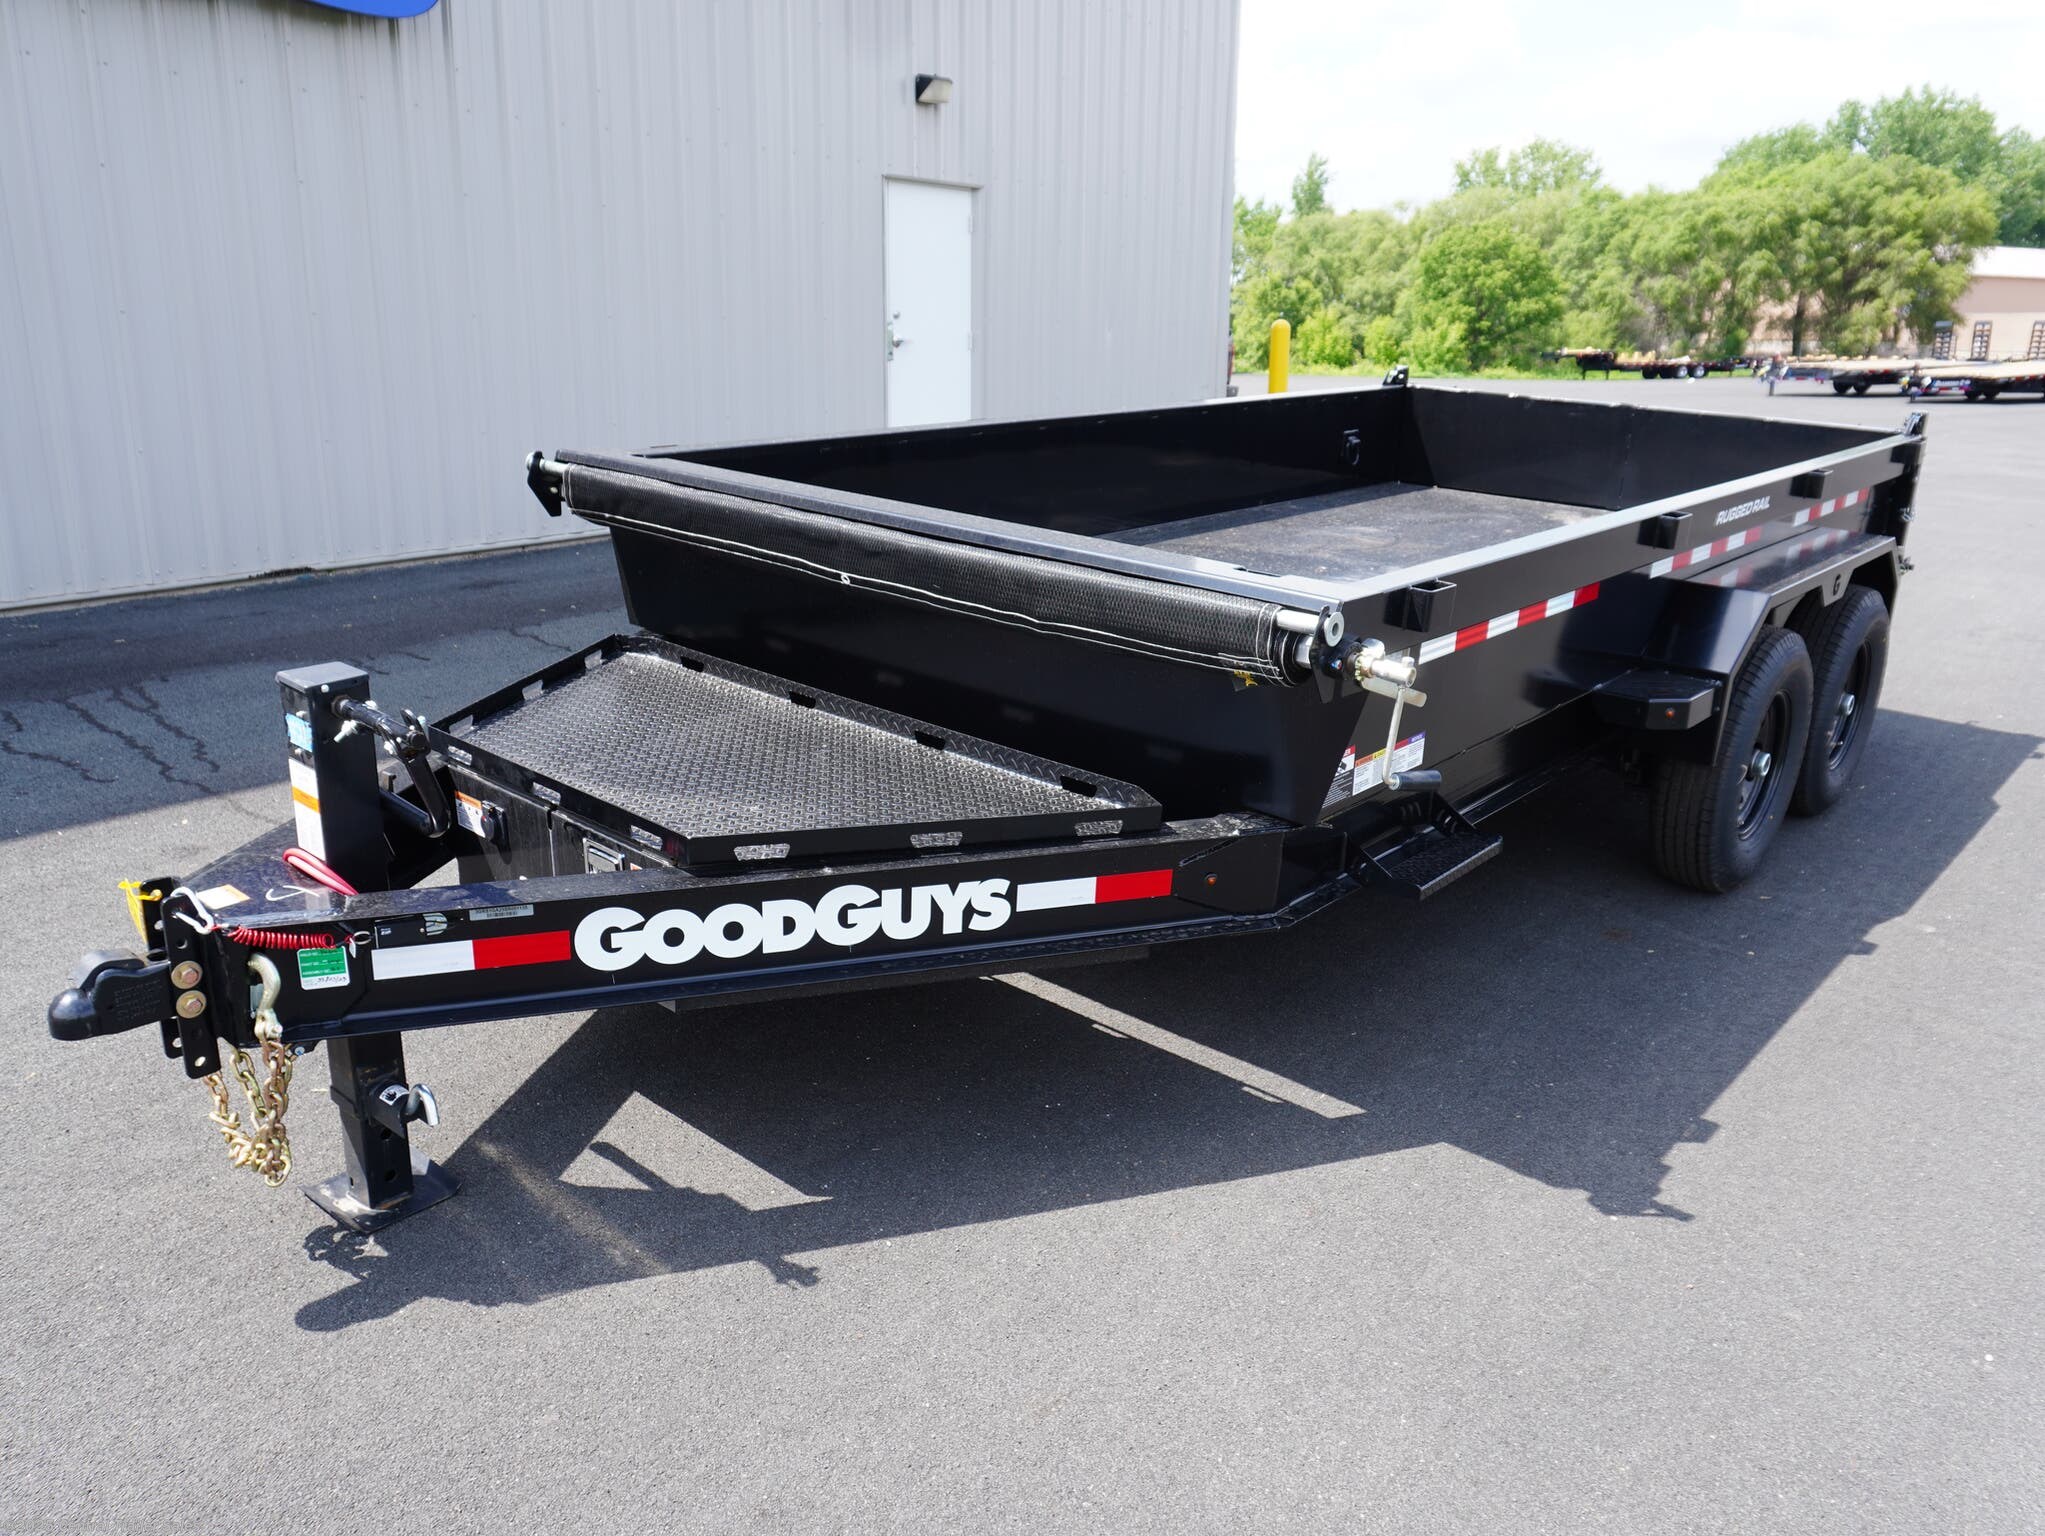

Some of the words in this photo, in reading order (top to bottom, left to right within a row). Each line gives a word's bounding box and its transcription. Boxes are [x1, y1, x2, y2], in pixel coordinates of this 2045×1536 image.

[1715, 501, 1754, 526] RUGGED
[1752, 495, 1771, 513] RAIL
[574, 879, 1012, 971] GOODGUYS
